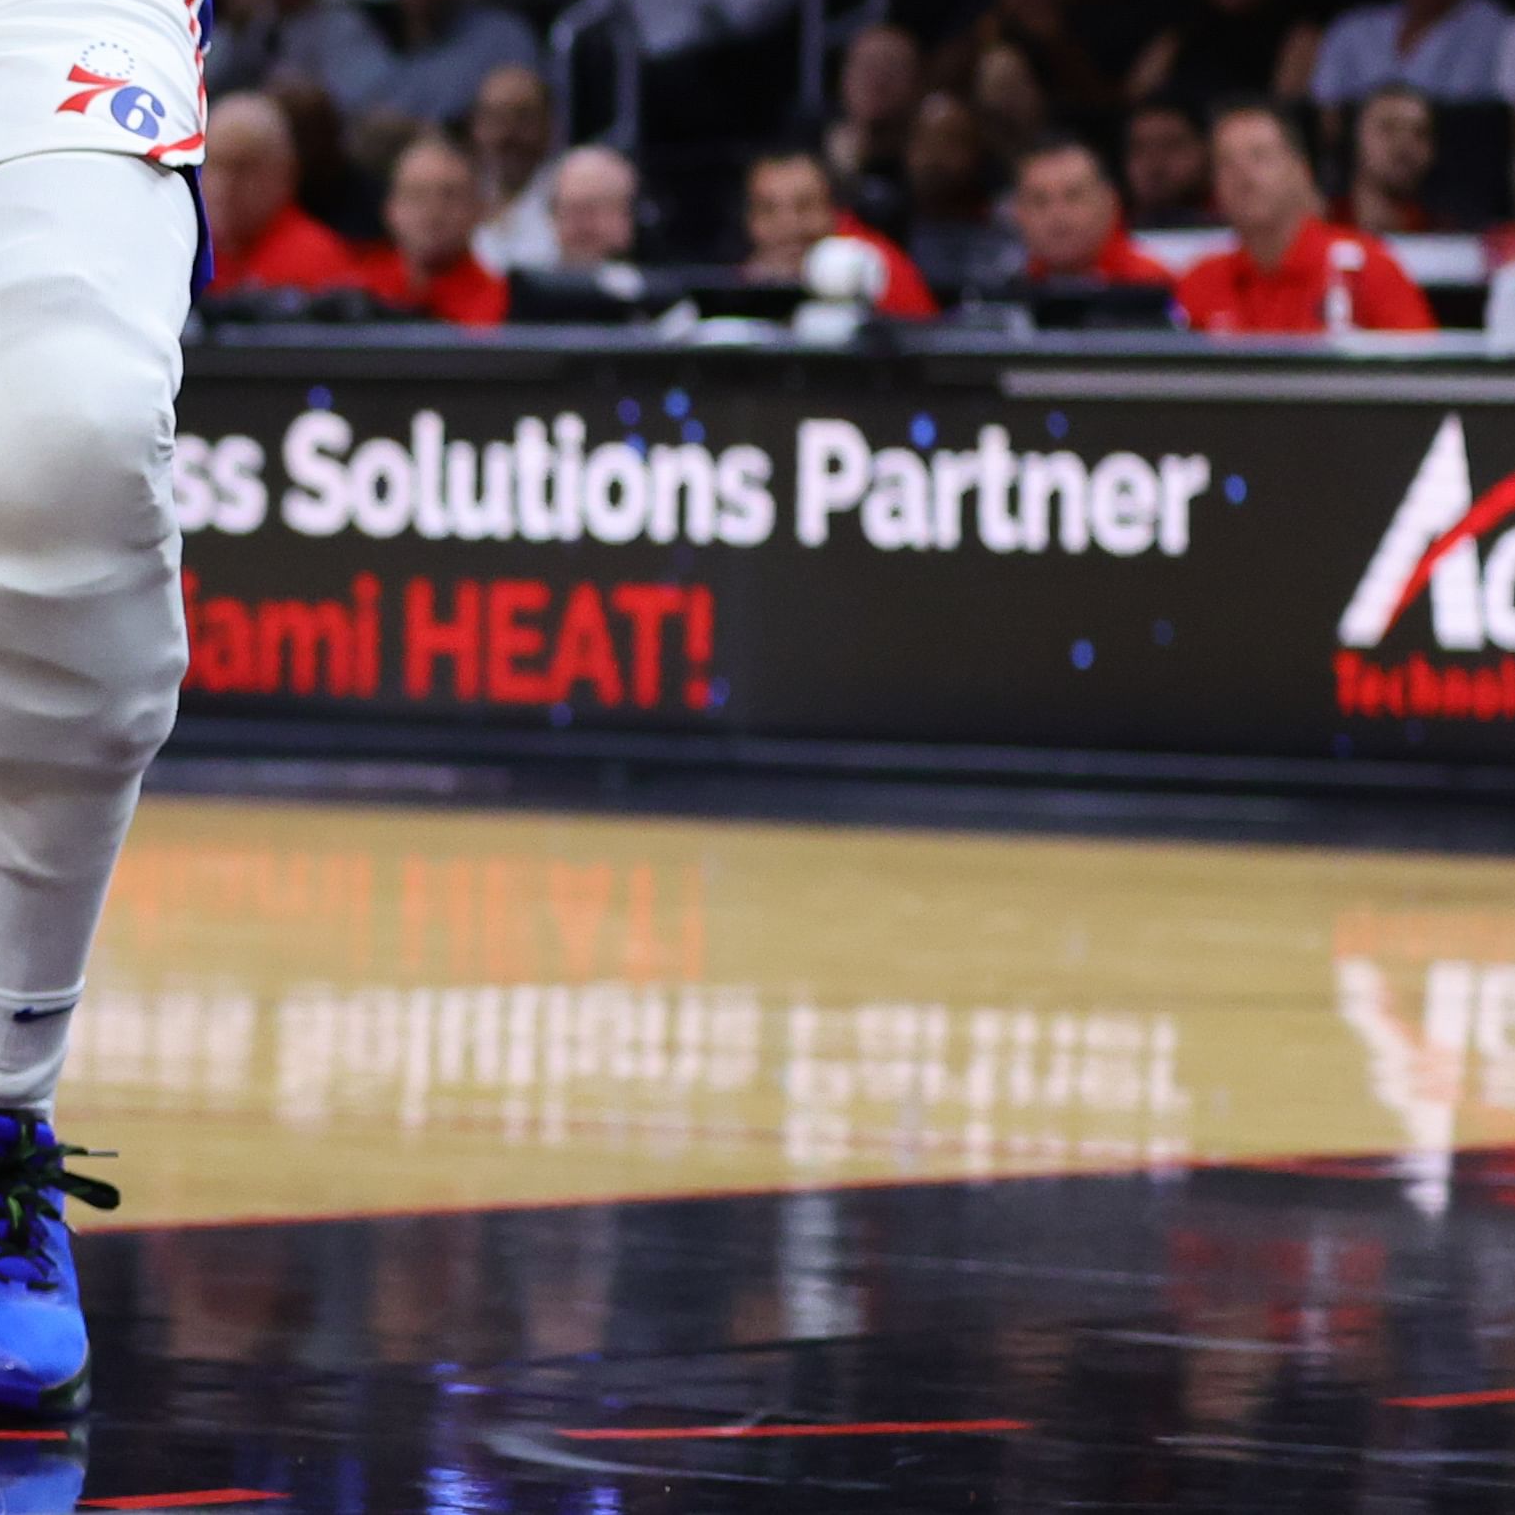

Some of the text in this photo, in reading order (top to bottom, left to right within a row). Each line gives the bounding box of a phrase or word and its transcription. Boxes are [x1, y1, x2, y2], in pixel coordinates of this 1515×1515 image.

[280, 408, 777, 548] Solutions
[794, 417, 1210, 557] Partner
[181, 567, 382, 700] iami
[403, 575, 716, 711] HEAT!
